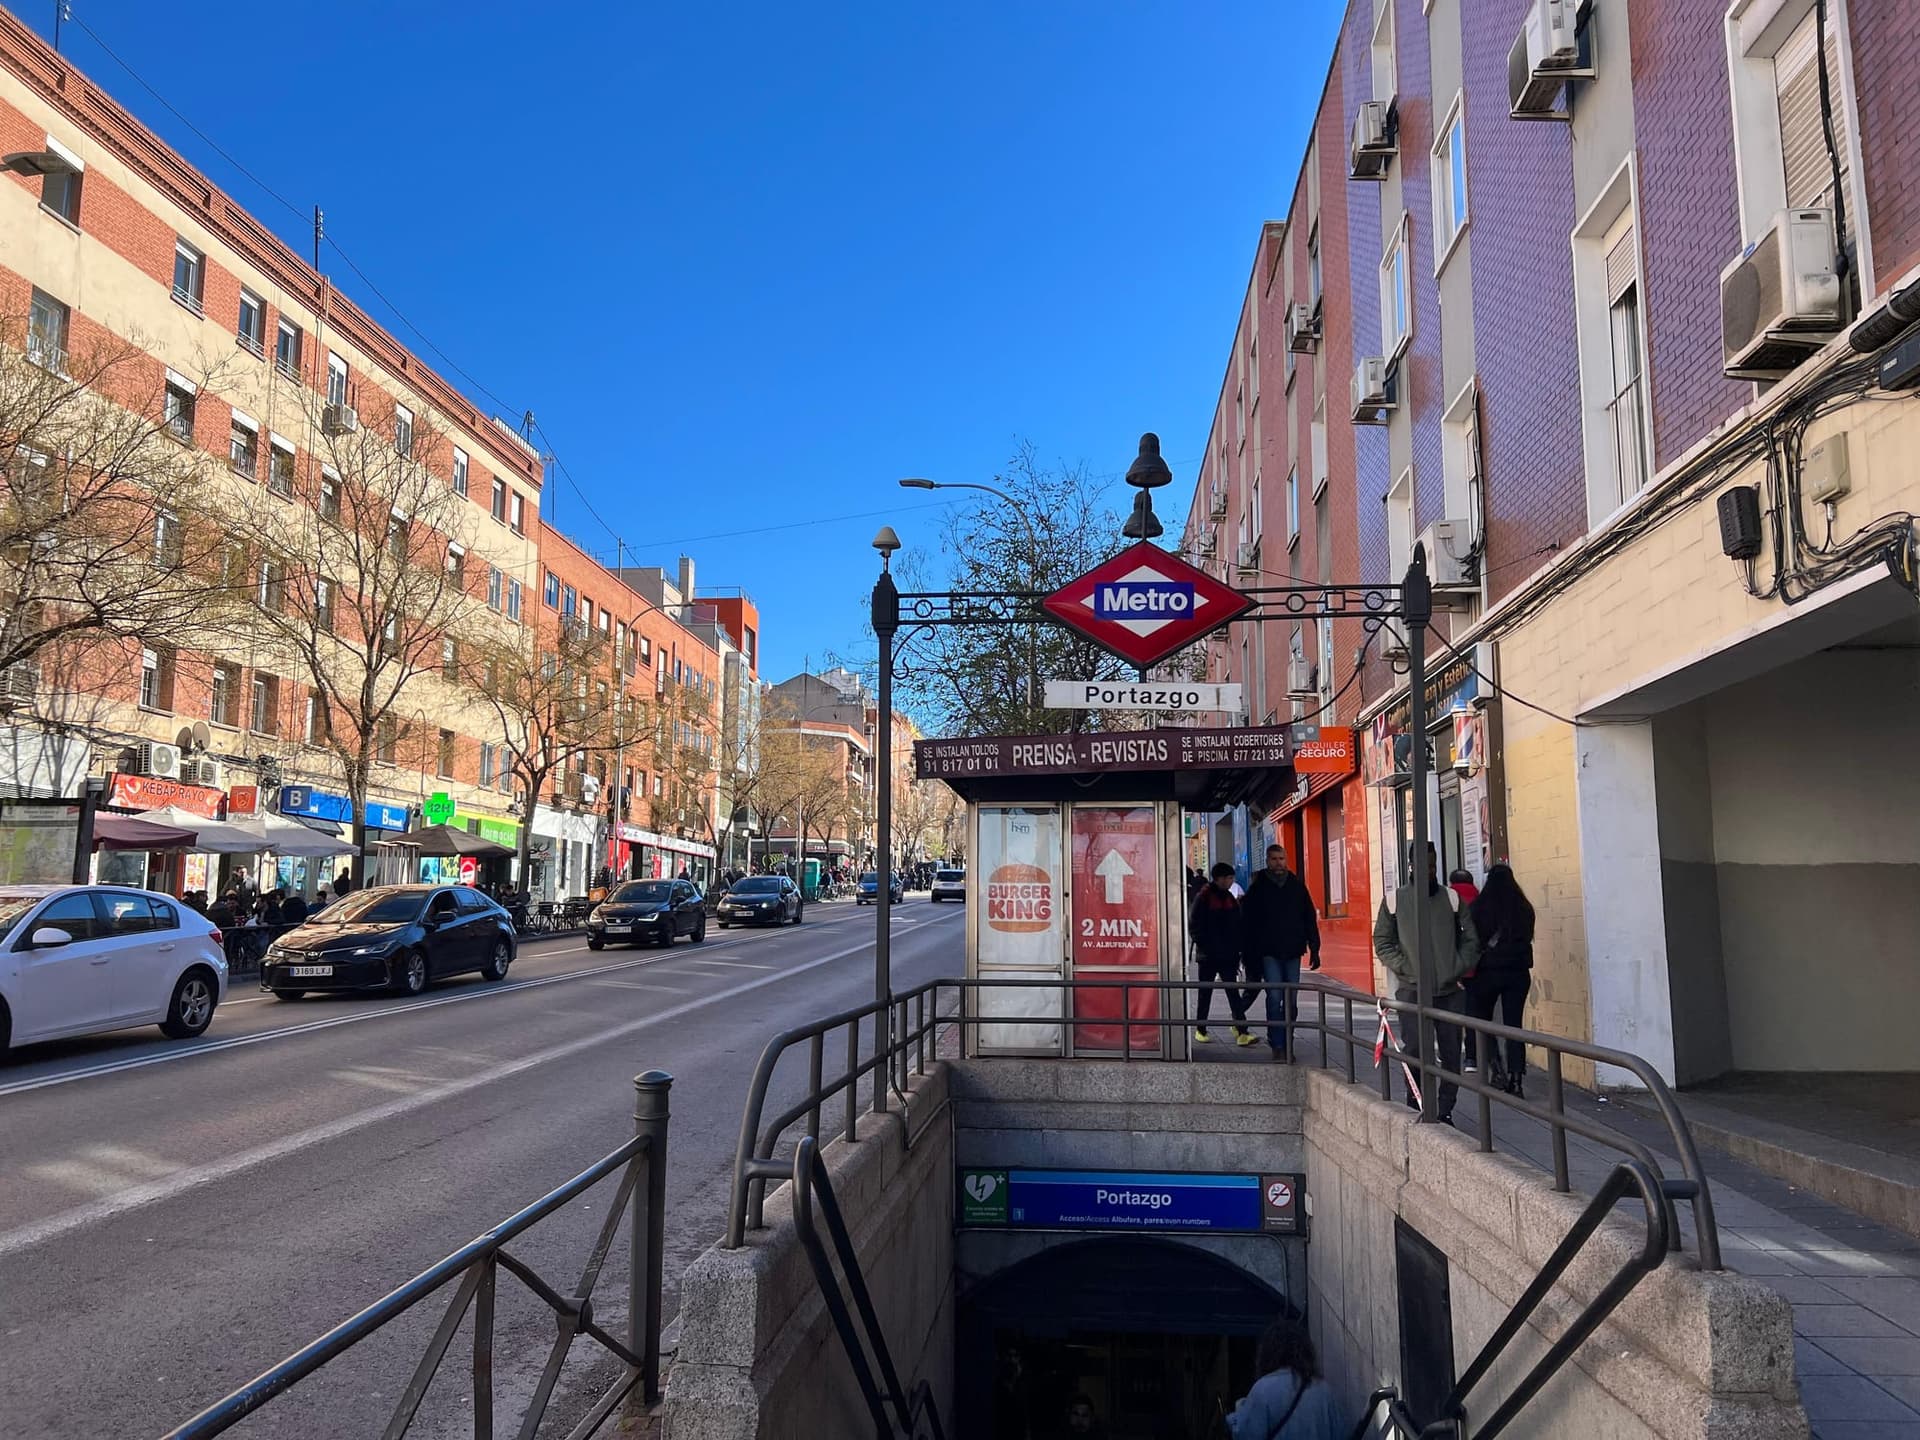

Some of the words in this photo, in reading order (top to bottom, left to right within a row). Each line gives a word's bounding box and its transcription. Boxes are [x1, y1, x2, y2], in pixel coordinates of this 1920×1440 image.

[1103, 587, 1188, 612] Metro
[1085, 686, 1200, 709] Portazgo
[1181, 736, 1191, 748] SE
[1194, 735, 1230, 747] INSTALAN
[1233, 733, 1284, 746] COBERTORES
[1301, 741, 1345, 749] ALQUILER
[923, 747, 933, 758] SE
[935, 745, 970, 758] INSTALAN
[970, 743, 999, 756] TOLDOS
[1012, 743, 1077, 767] PRENSA
[1091, 739, 1168, 763] REVISTAS
[1182, 750, 1193, 763] DE
[1197, 750, 1229, 762] PISCINA
[1233, 749, 1248, 761] 677
[1251, 749, 1266, 761] 221
[1269, 748, 1284, 760] 334
[924, 760, 937, 773] 91
[942, 759, 963, 772] 817
[967, 758, 980, 770] 01
[985, 757, 999, 770] 01
[143, 782, 176, 797] KEBAP
[178, 788, 206, 801] RAYO
[289, 790, 302, 807] B
[382, 808, 389, 825] B
[988, 885, 1052, 899] BURGER
[988, 899, 1052, 920] KING
[1081, 918, 1095, 937] 2
[1099, 918, 1149, 937] MIN.
[1096, 1189, 1172, 1209] Portazgo
